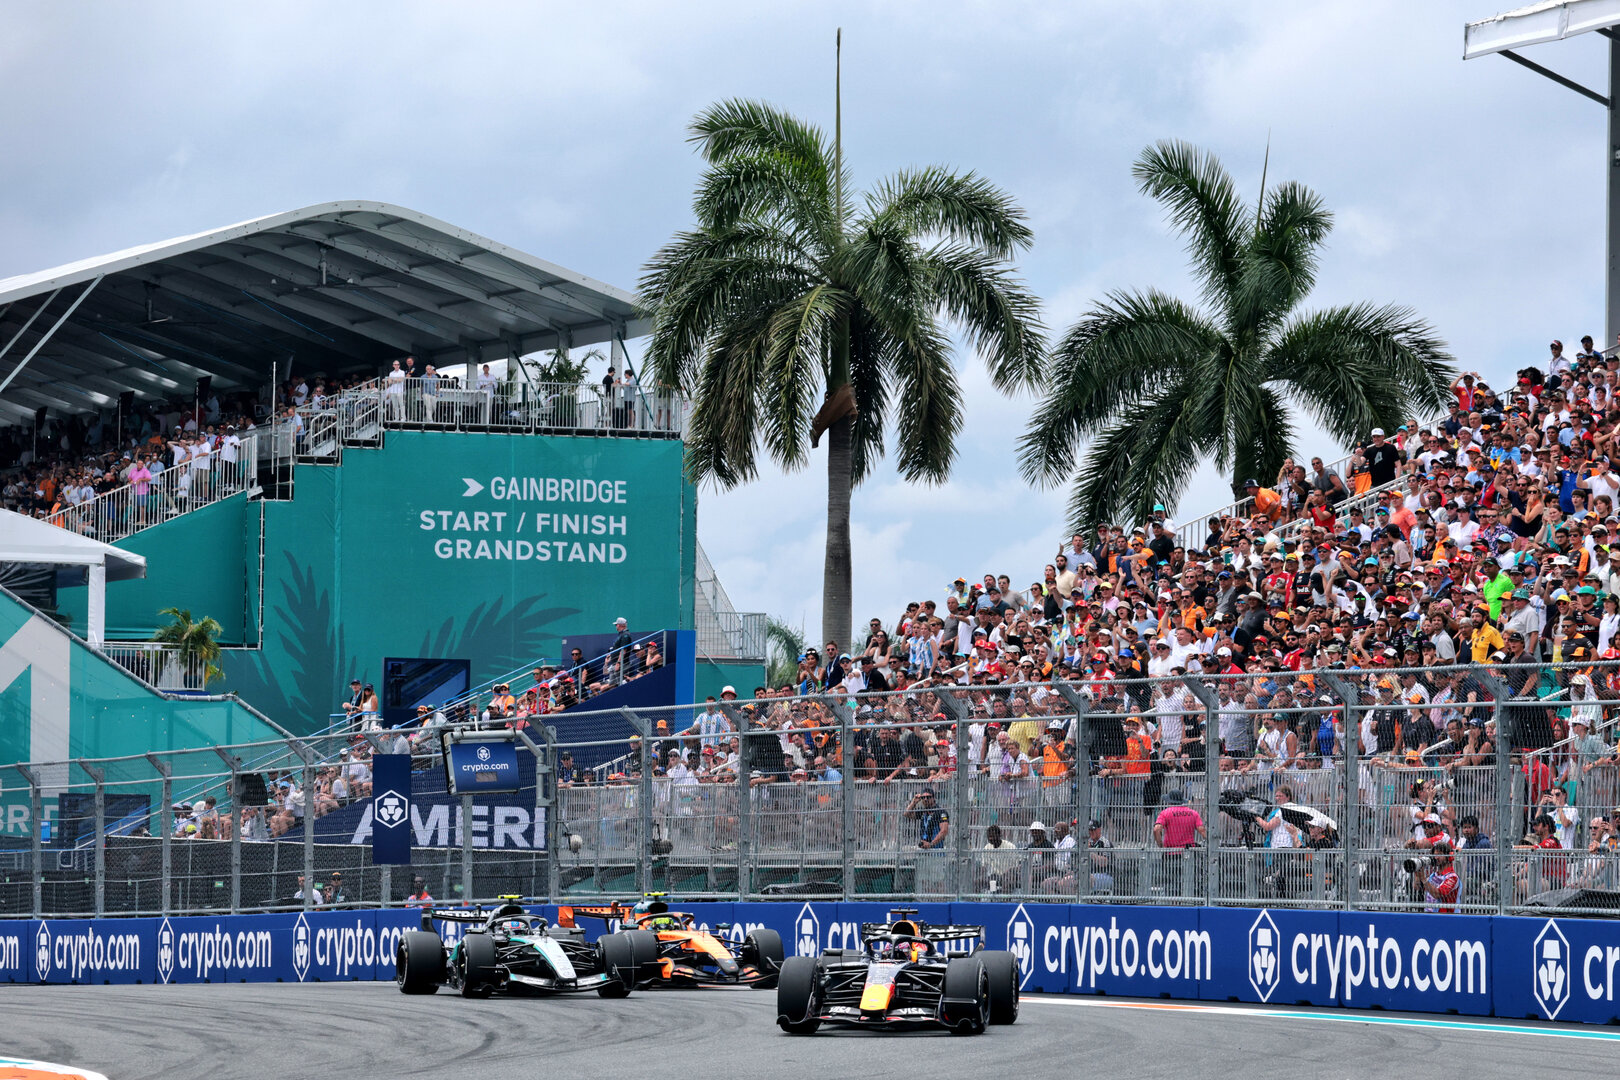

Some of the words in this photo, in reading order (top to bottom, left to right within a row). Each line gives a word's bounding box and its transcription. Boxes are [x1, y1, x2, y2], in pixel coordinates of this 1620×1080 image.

[490, 476, 627, 504] GAINBRIDGE
[419, 510, 507, 532] START
[536, 512, 627, 536] FINISH
[434, 538, 627, 564] GRANDSTAND
[462, 761, 509, 773] crypto.com
[55, 927, 140, 978] crypto.com
[179, 924, 272, 978] crypto.com
[316, 919, 418, 976] crypto.co
[1044, 916, 1212, 988] crypto.com
[1291, 924, 1487, 1000] crypto.com
[899, 1008, 926, 1016] VISA
